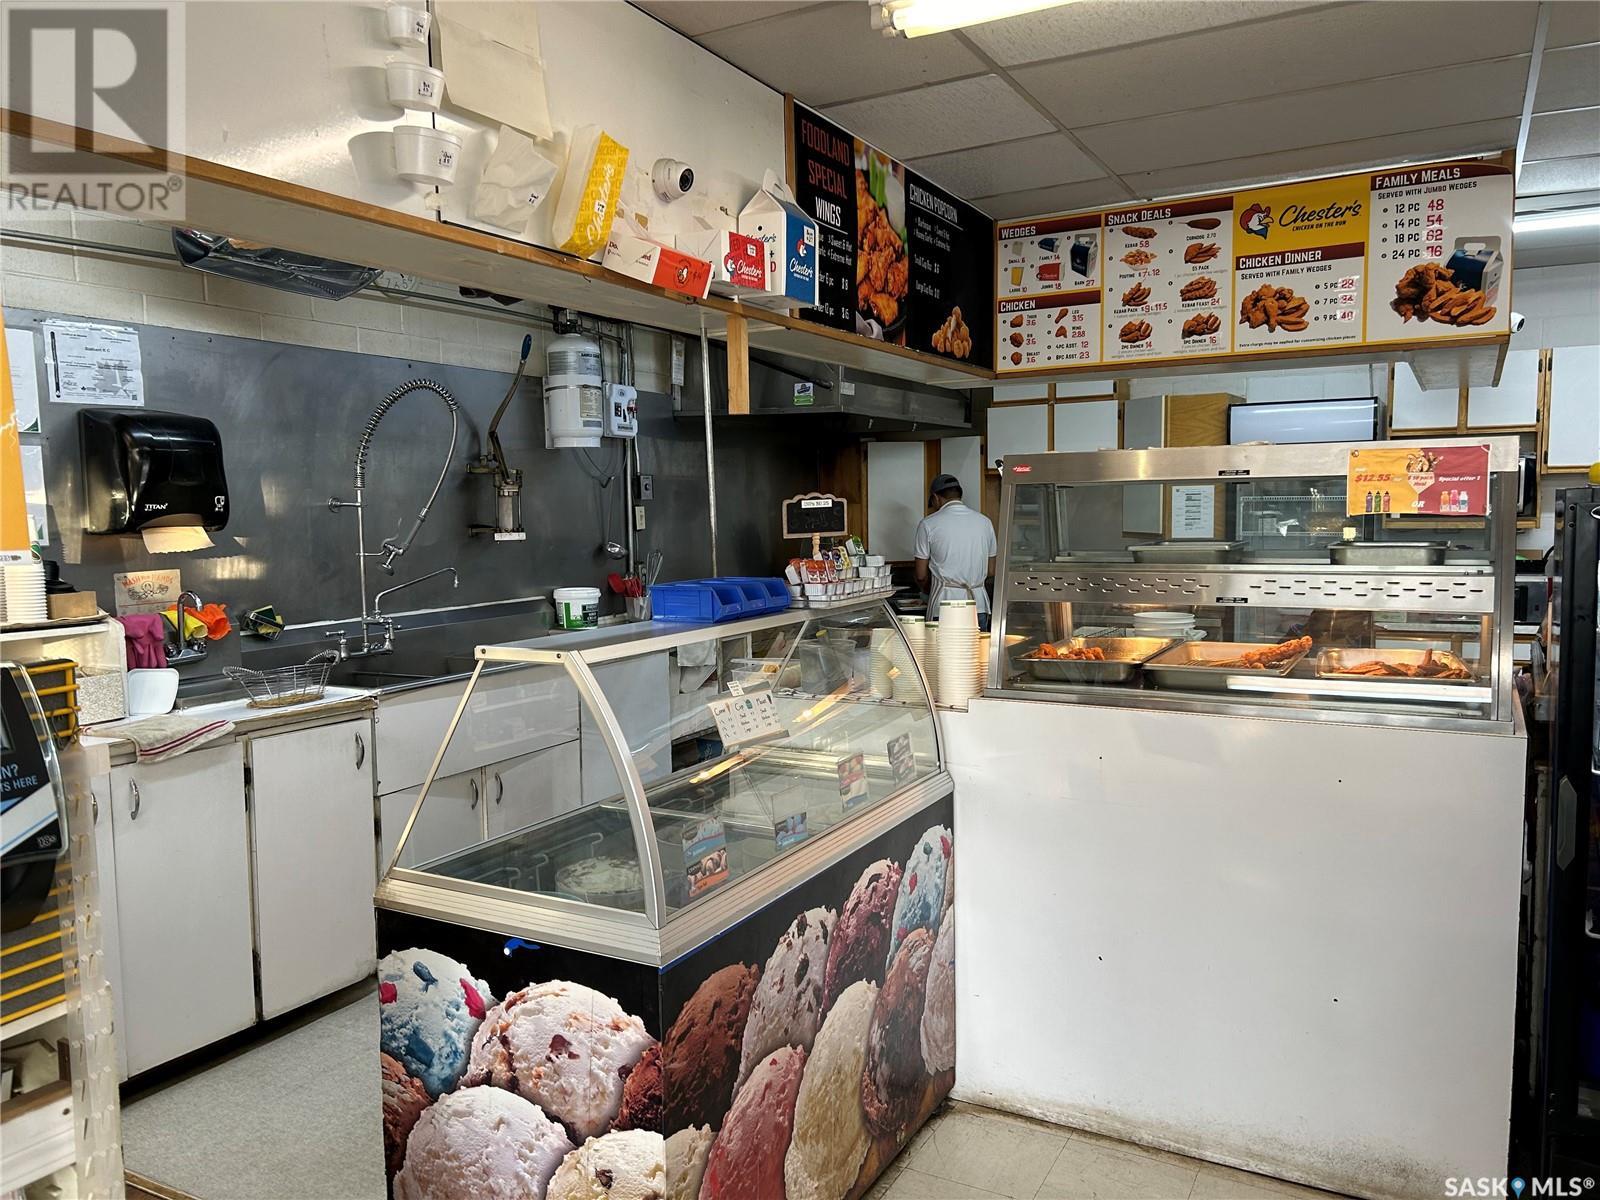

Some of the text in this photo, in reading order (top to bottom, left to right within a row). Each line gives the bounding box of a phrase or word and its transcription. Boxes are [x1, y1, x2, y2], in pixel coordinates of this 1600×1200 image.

[802, 118, 850, 166] FOODLAND
[808, 159, 848, 200] SPECIAL
[1376, 168, 1461, 190] FAMILY MEALS
[1378, 181, 1477, 200] SERVED WITH JUMBO WEDGES
[816, 196, 841, 227] WINGS
[910, 183, 958, 224] CHICKEN POPCORN
[1396, 199, 1444, 214] 12 PC 48
[1108, 208, 1171, 225] SNACK DEALS
[1279, 200, 1362, 227] Chester's
[1394, 214, 1444, 229] 14 PC 54
[1001, 226, 1036, 239] WEDGES
[1395, 229, 1443, 244] 18 PC 62
[1240, 250, 1322, 269] CHICKEN DINNER
[1392, 246, 1442, 260] 24 PC 76
[736, 260, 762, 278] Chester's
[790, 258, 813, 278] Chester's
[1241, 264, 1332, 280] SERVED WITH FAMILY WEDGES
[1000, 300, 1036, 312] CHICKEN
[13, 776, 38, 789] HERE
